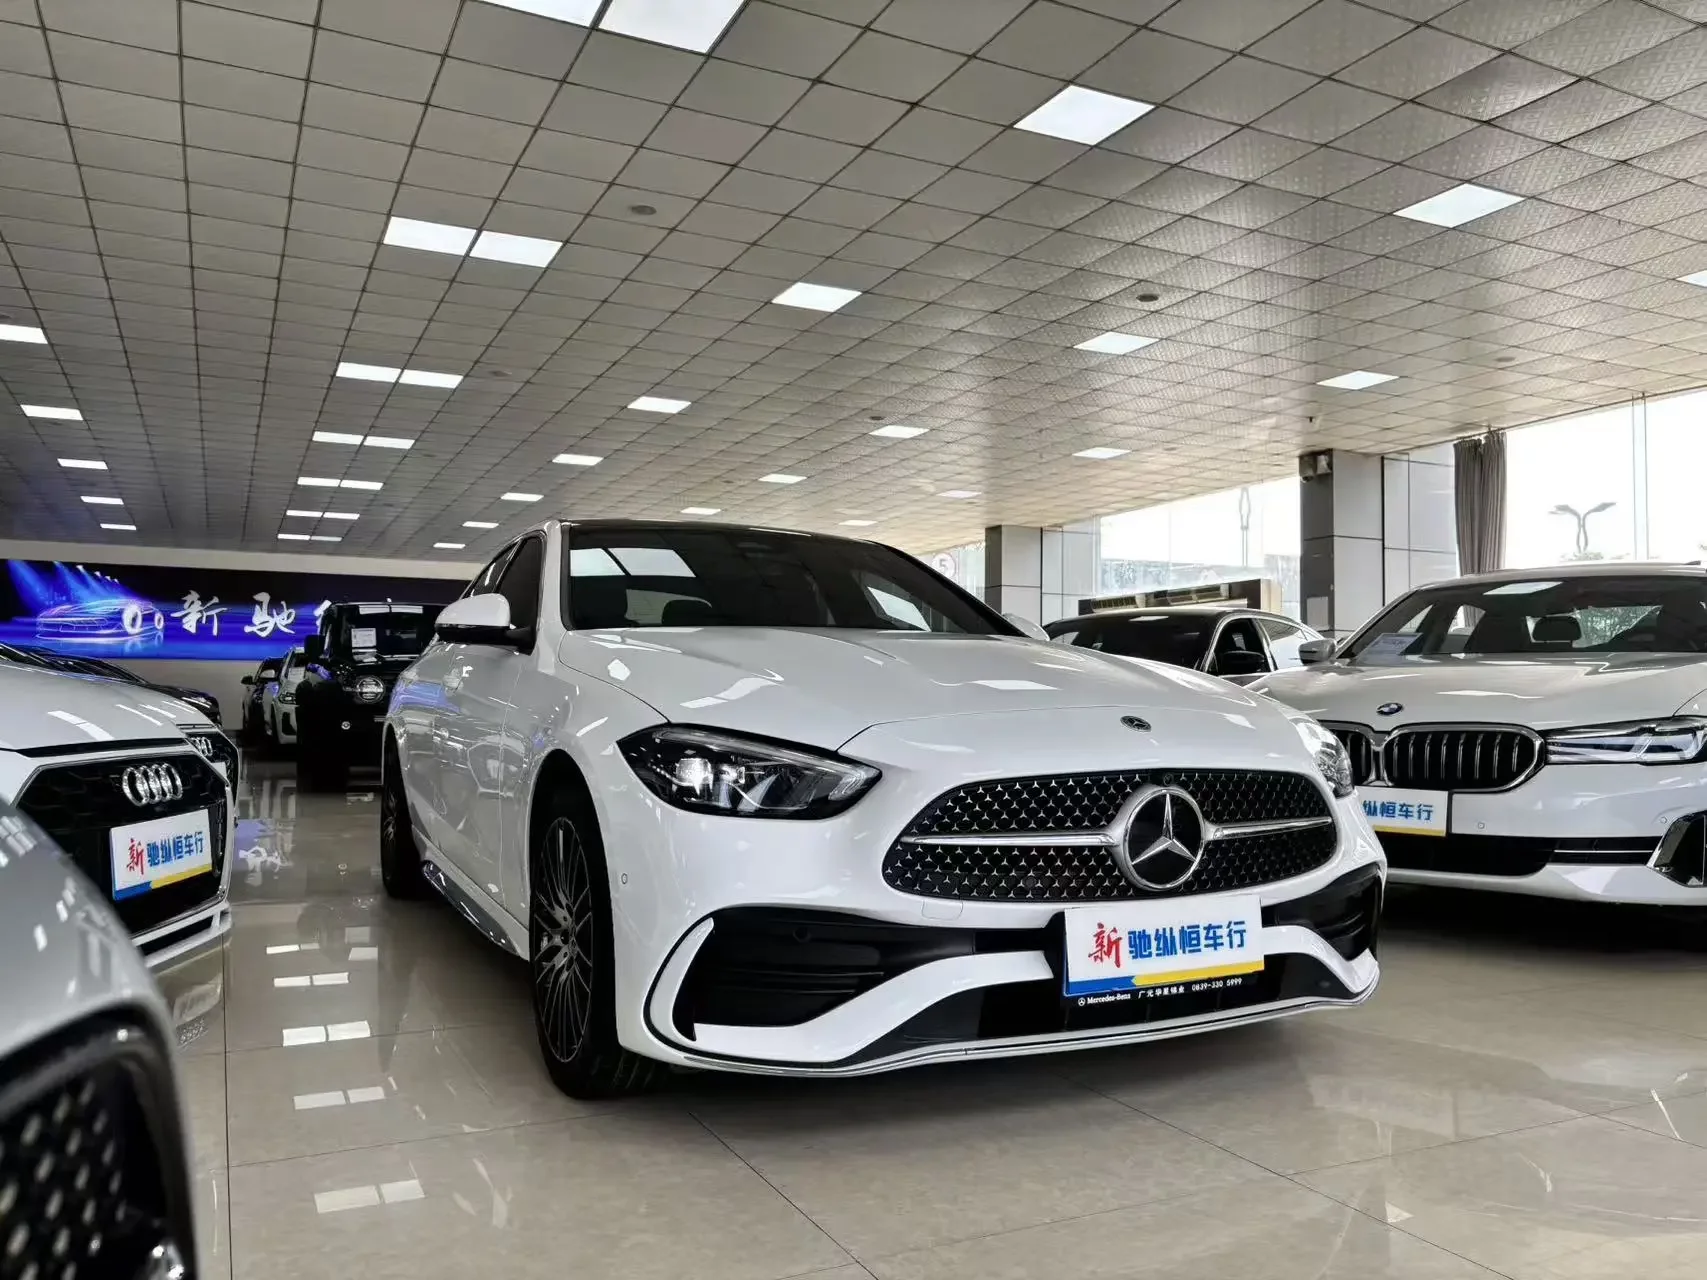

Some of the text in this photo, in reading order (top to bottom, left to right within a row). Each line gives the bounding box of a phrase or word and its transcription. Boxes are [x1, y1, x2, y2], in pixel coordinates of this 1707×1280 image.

[1088, 920, 1247, 968] 新驰纵恒车行
[1087, 993, 1131, 1004] Mercedes-Benz
